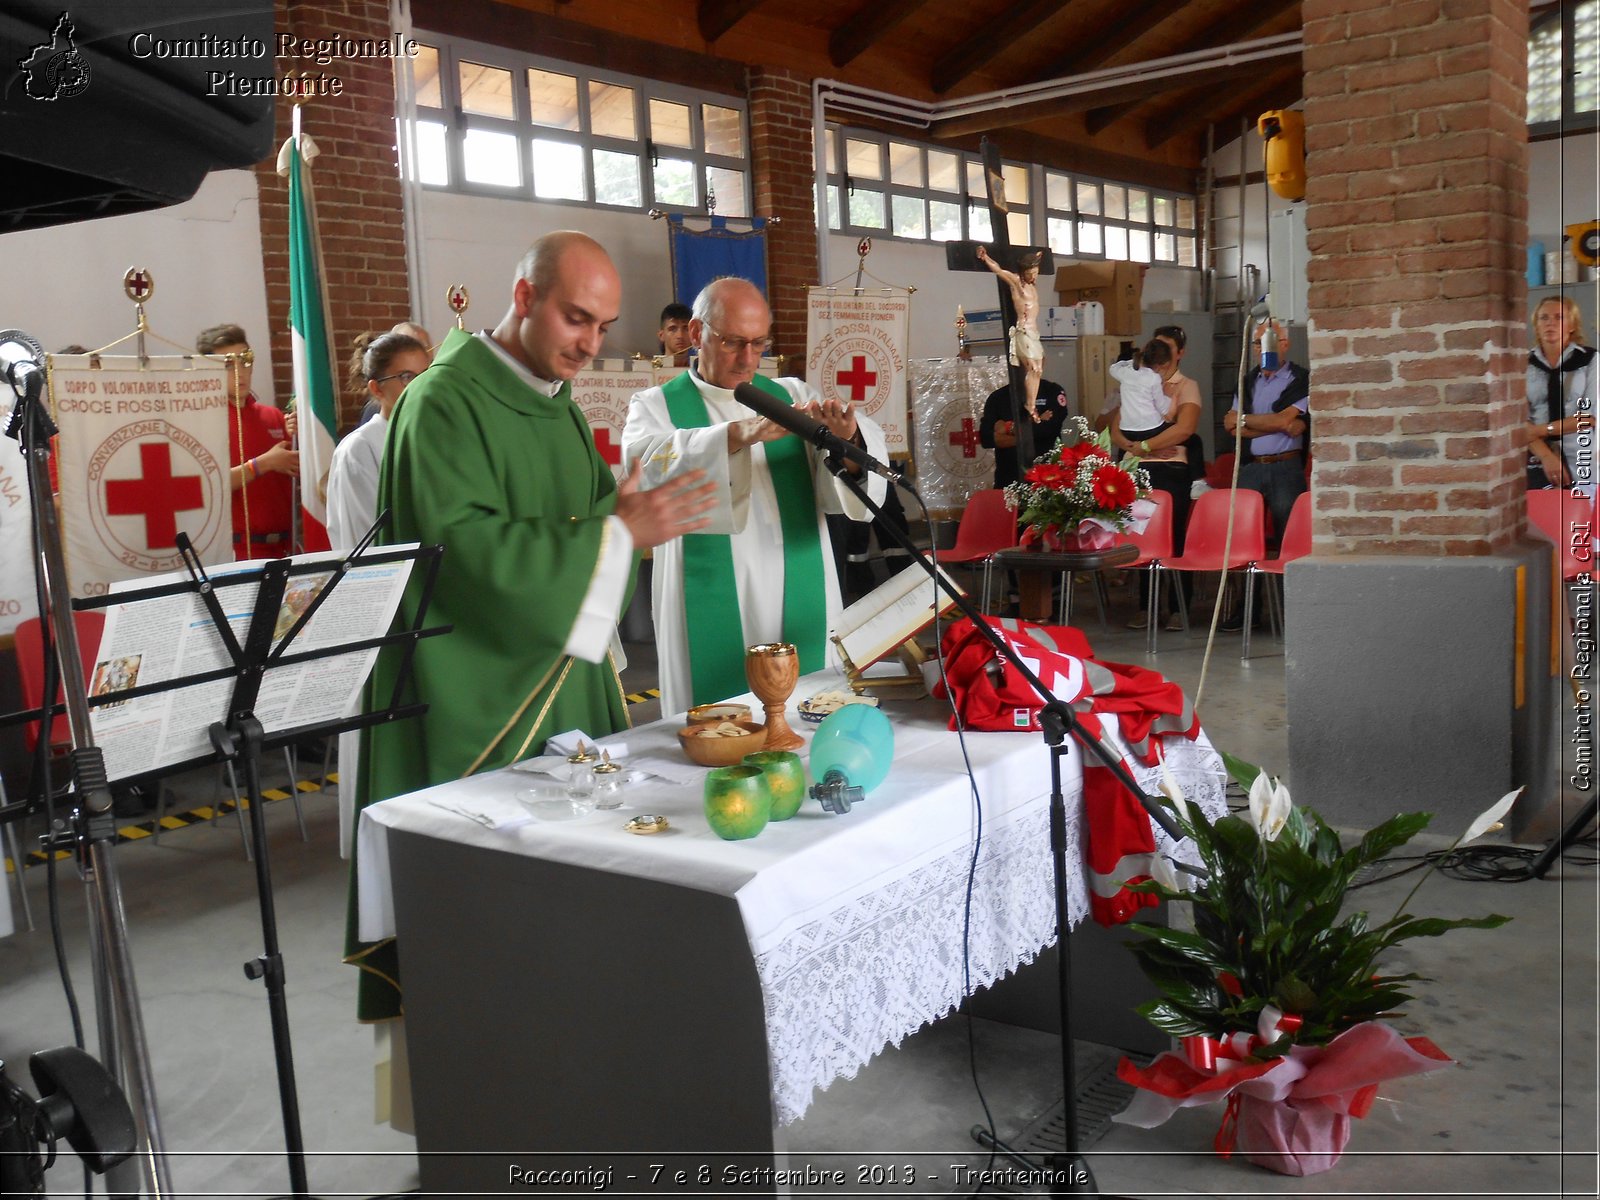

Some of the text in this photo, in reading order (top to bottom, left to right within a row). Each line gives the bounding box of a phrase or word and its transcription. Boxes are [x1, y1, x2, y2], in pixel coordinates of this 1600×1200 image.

[809, 322, 904, 373] CROCE ROSSA ITALIANA
[823, 357, 837, 400] ENZIONE
[847, 340, 879, 357] GINEVRA
[64, 378, 222, 395] CORPO VOLONTARI DEL SOCCORSO
[572, 377, 603, 388] OLONTARI
[58, 399, 112, 414] CROCE
[118, 398, 166, 414] ROSSA
[574, 391, 612, 407] ROSSA
[89, 421, 161, 481] CONVENZIONE
[172, 430, 218, 475] GINEVRA
